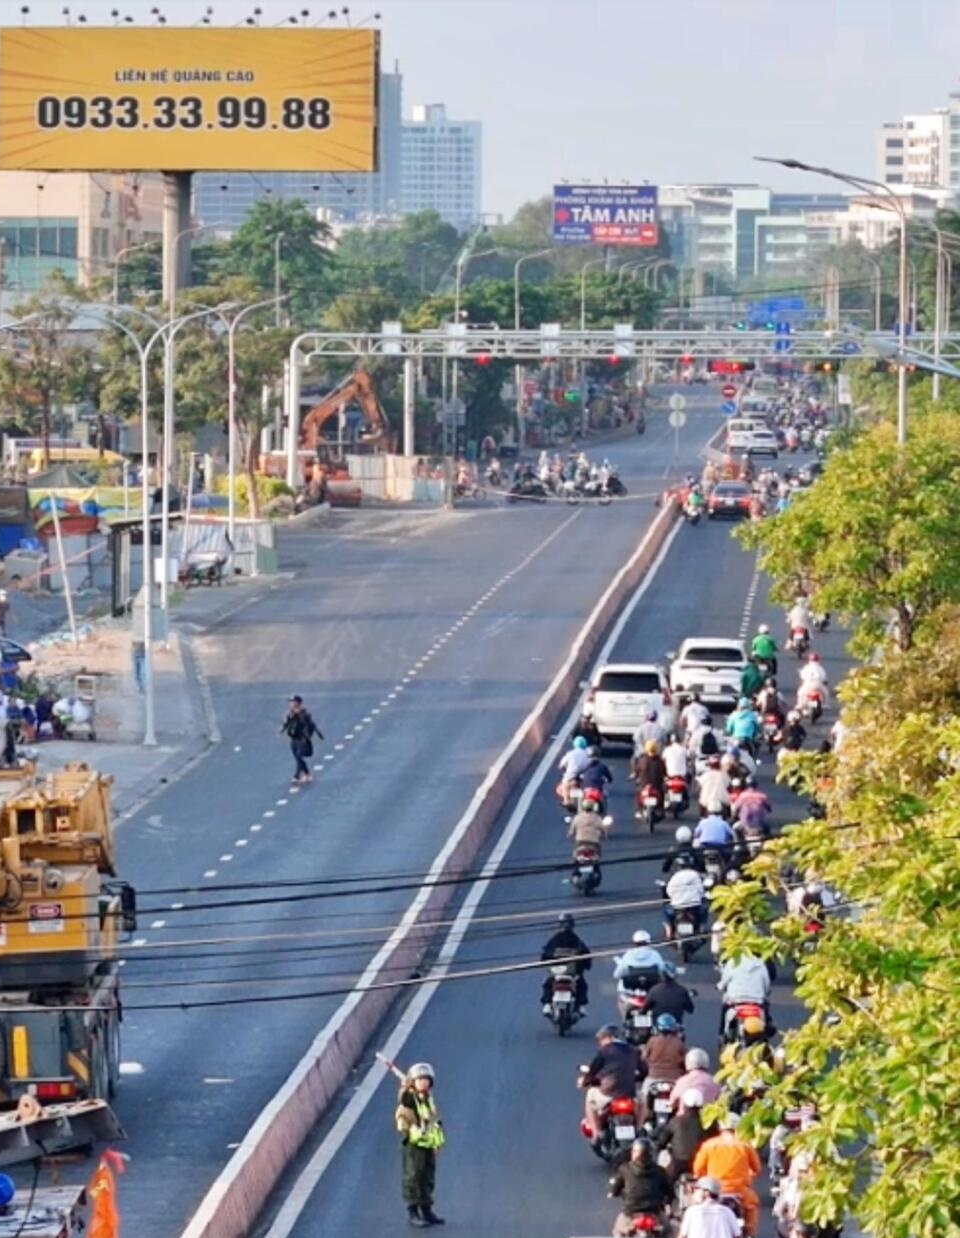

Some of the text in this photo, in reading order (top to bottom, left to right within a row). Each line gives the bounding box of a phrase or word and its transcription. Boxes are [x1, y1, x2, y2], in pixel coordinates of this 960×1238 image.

[114, 68, 146, 83] LIÊN
[226, 68, 255, 83] CÁO
[37, 95, 332, 130] 0933.33.99.88
[571, 204, 655, 223] TÂM ANH
